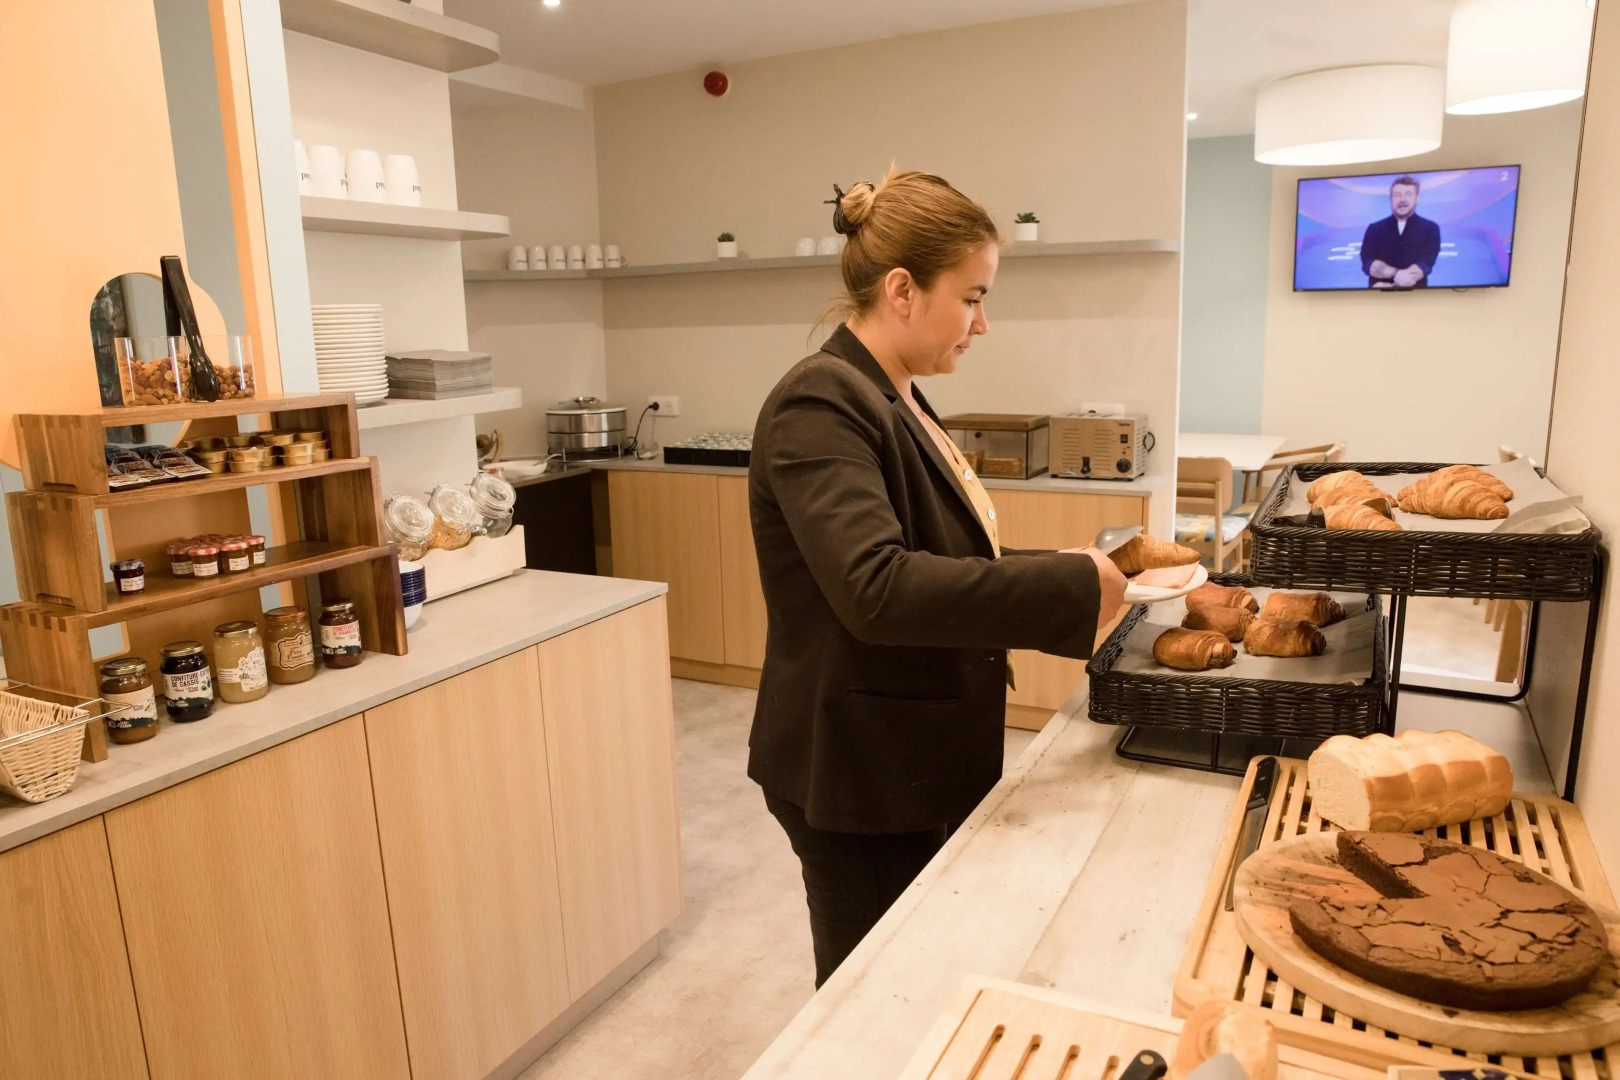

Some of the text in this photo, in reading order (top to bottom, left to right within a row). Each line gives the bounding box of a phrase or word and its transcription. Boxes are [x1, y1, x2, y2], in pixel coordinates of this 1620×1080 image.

[117, 460, 145, 469] nutella
[171, 672, 199, 681] CONFITURE
[180, 678, 200, 687] CASSIS
